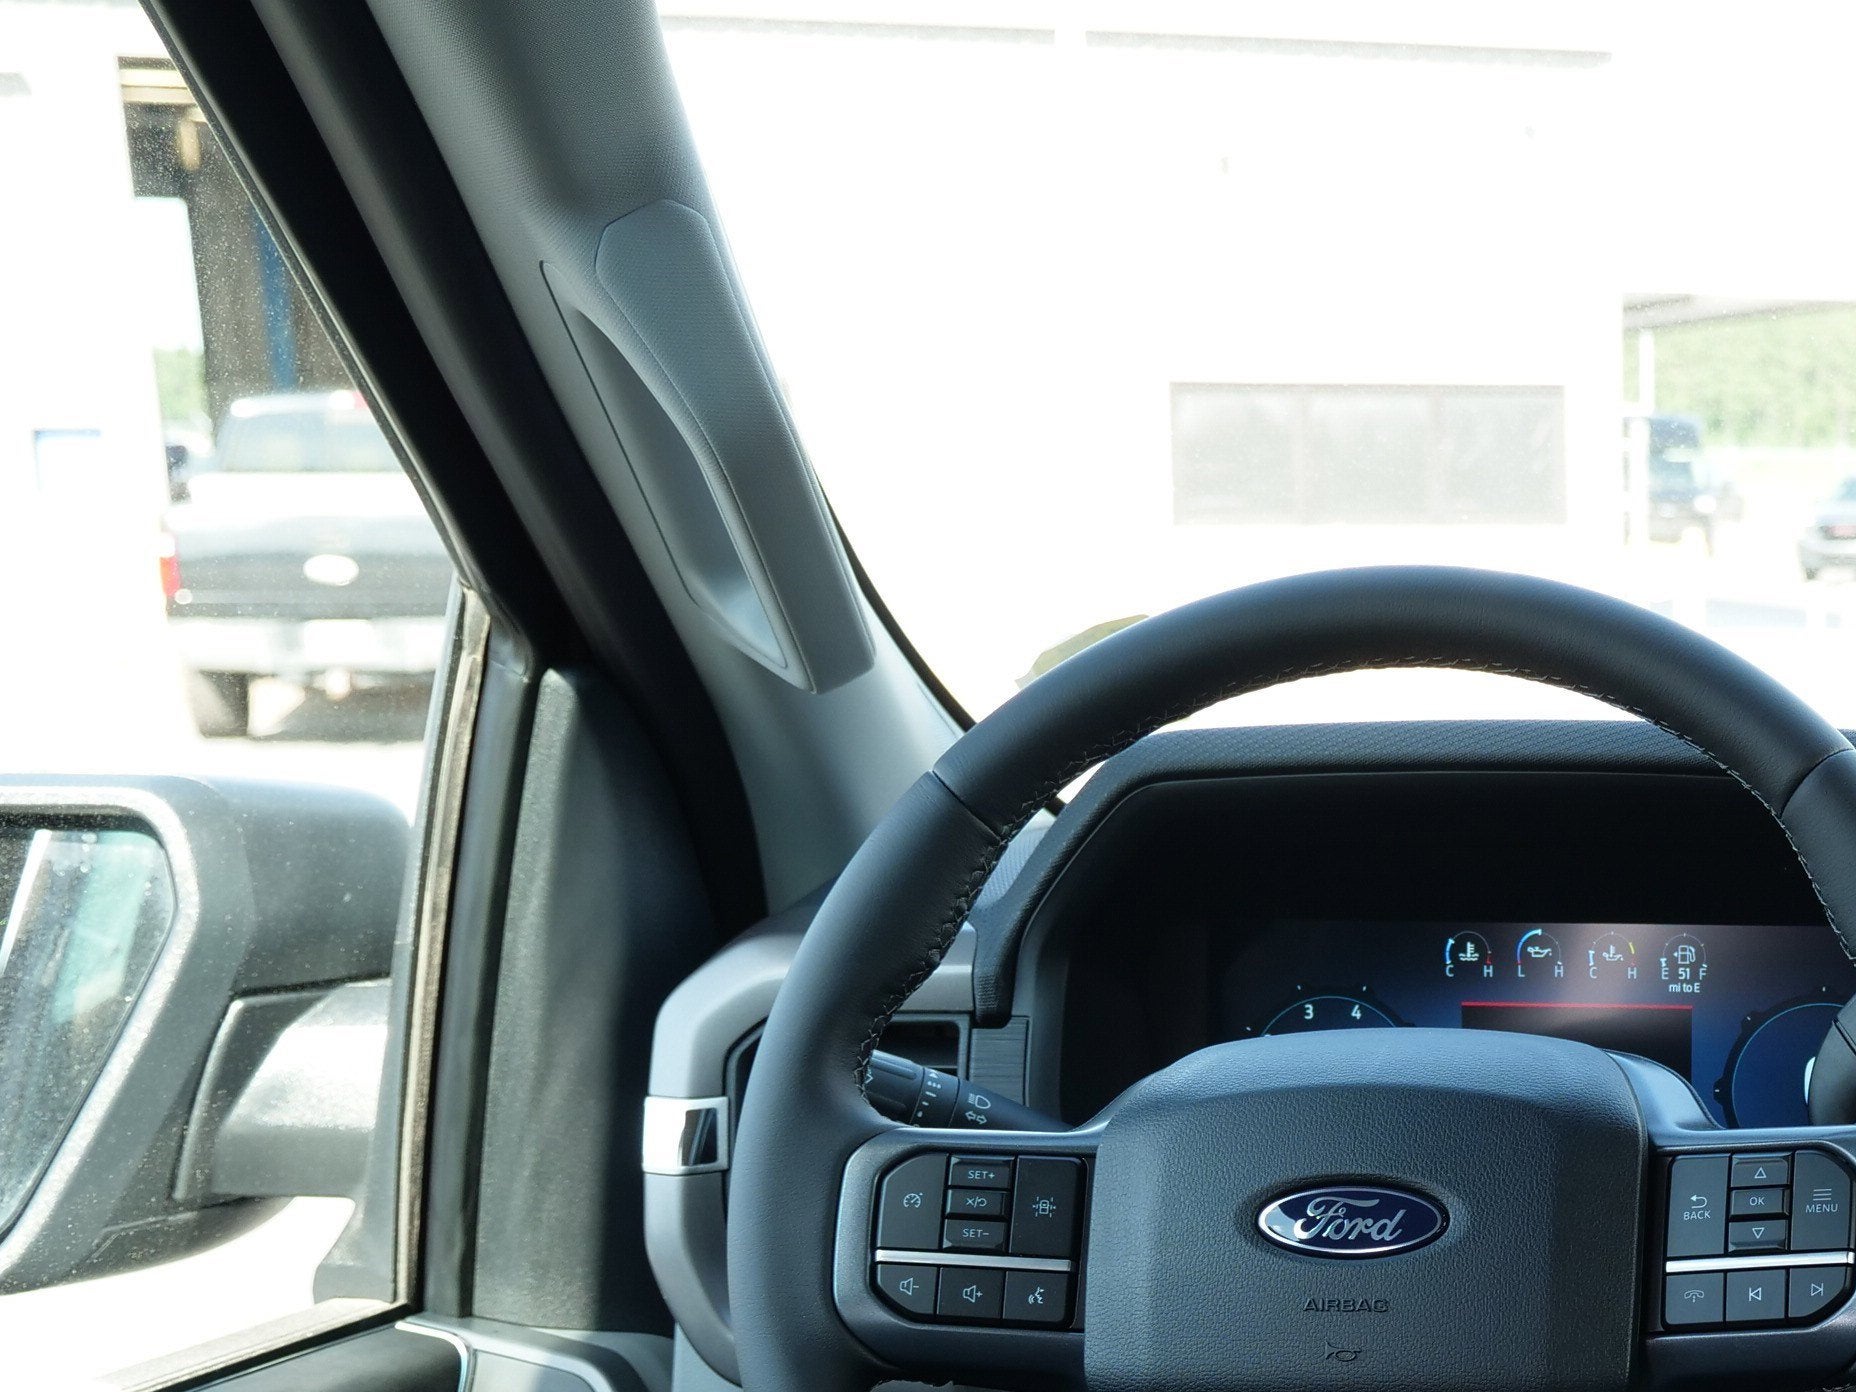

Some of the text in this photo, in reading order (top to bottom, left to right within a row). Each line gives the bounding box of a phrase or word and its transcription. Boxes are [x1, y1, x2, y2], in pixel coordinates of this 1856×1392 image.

[1445, 965, 1454, 977] C
[1483, 965, 1493, 977] H
[1518, 965, 1525, 977] L
[1554, 965, 1563, 977] H
[1589, 966, 1597, 979] C
[1628, 966, 1637, 979] H
[1661, 968, 1669, 980] E
[1678, 967, 1691, 980] 51
[1669, 982, 1700, 993] mi to E
[1304, 1004, 1314, 1019] 3
[1351, 1004, 1362, 1020] 4
[1749, 1196, 1764, 1206] OK
[1806, 1204, 1838, 1213] MENU
[1293, 1196, 1407, 1241] Ford
[1683, 1210, 1711, 1221] BACK
[1302, 1298, 1391, 1313] AIRBAG
